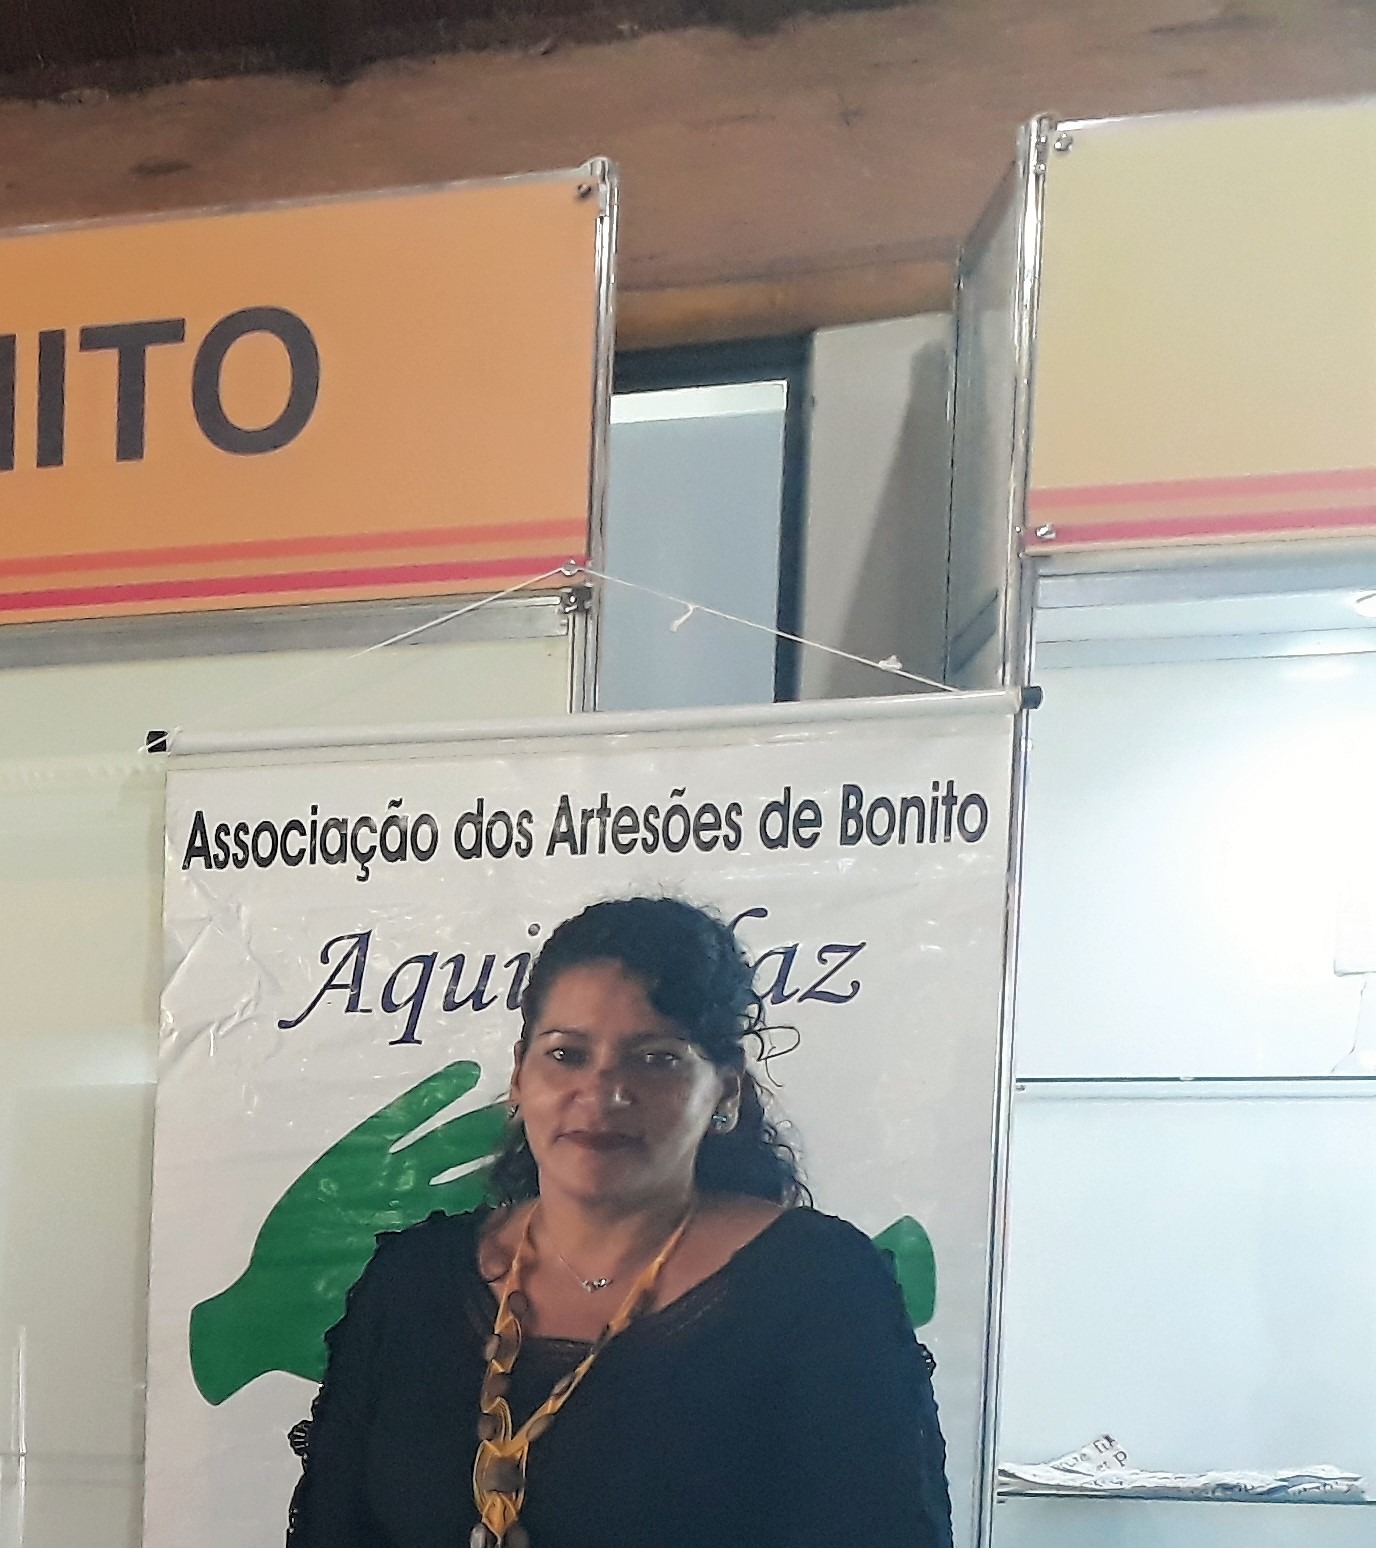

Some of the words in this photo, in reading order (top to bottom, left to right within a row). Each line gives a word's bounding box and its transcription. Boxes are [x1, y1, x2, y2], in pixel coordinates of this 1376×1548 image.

[181, 797, 439, 883] Associação
[454, 797, 534, 860] dos
[545, 786, 743, 857] Artesões
[759, 785, 823, 851] de
[839, 779, 989, 847] Bonito
[278, 923, 541, 1046] Aqui
